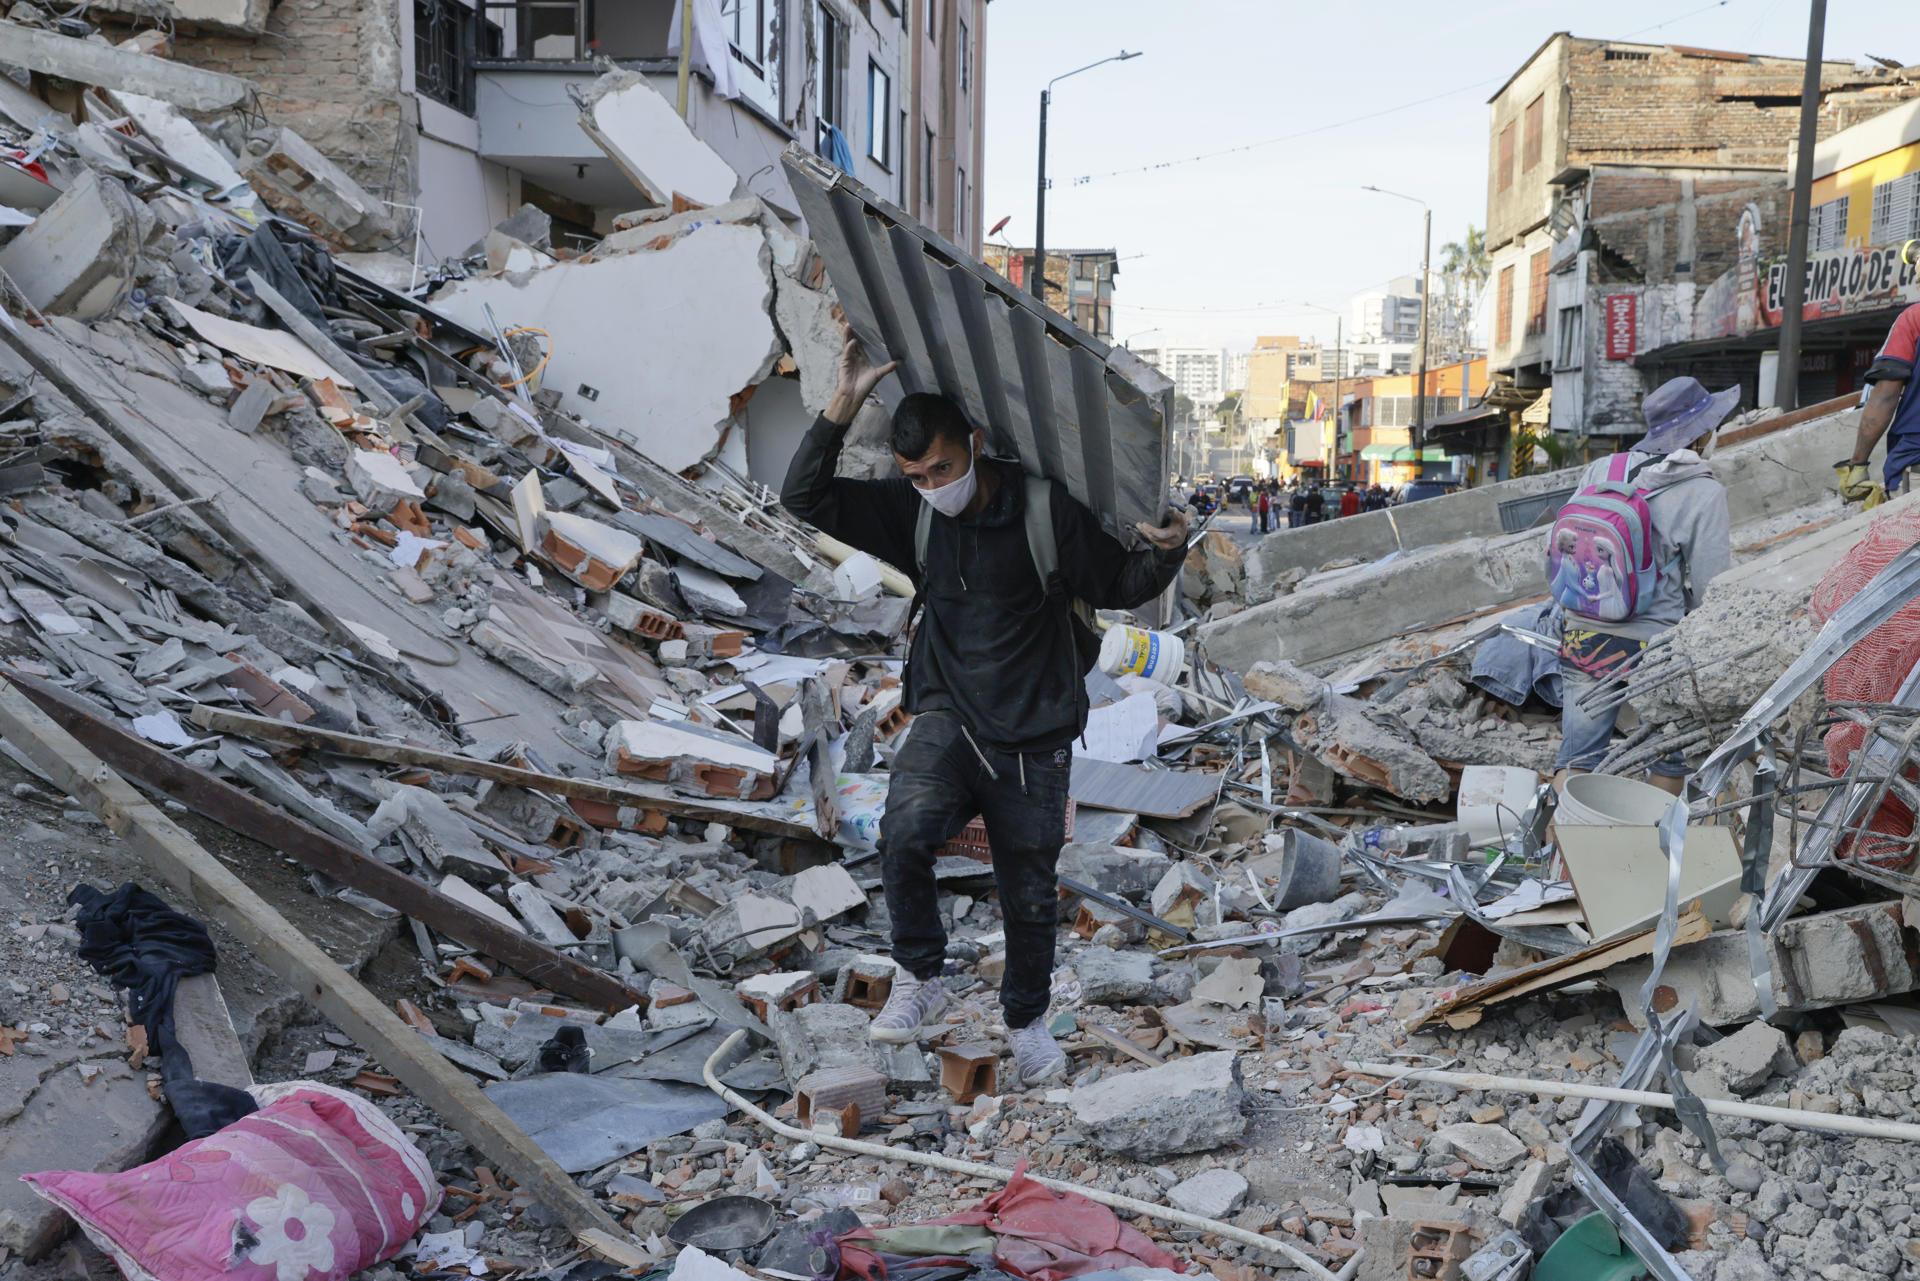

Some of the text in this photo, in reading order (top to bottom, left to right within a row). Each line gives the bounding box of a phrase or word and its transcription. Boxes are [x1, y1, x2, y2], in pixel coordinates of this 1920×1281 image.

[1769, 265, 1786, 309] EL
[1804, 254, 1863, 302] EMPLO
[1867, 250, 1896, 291] DE
[1147, 642, 1157, 670] corona
